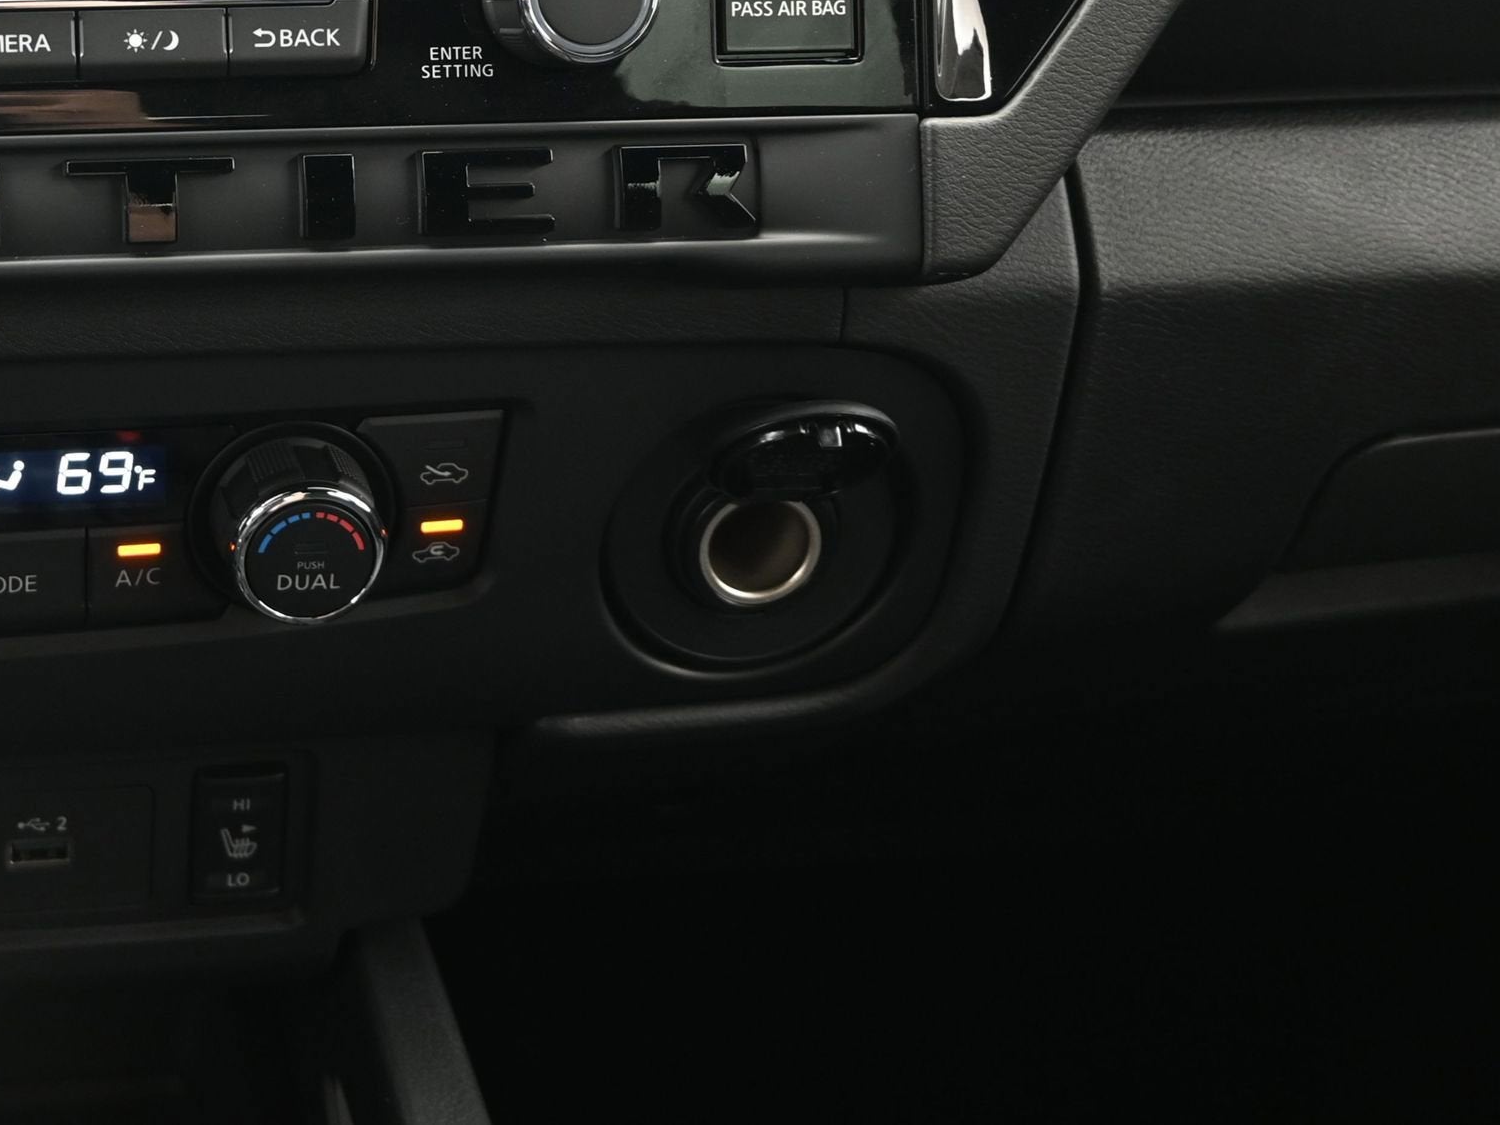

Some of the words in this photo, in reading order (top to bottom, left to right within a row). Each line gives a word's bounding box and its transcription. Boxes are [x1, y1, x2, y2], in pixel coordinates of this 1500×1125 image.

[731, 0, 774, 17] PASS
[777, 0, 808, 17] AIR
[811, 0, 846, 16] BAG
[279, 28, 341, 48] BACK
[429, 45, 483, 61] ENTER
[421, 63, 494, 79] SETTING
[296, 561, 325, 570] PUSH
[115, 567, 159, 588] A/C
[277, 573, 340, 591] DUAL
[232, 798, 251, 811] HI
[57, 816, 67, 831] 2
[226, 872, 250, 888] LO
